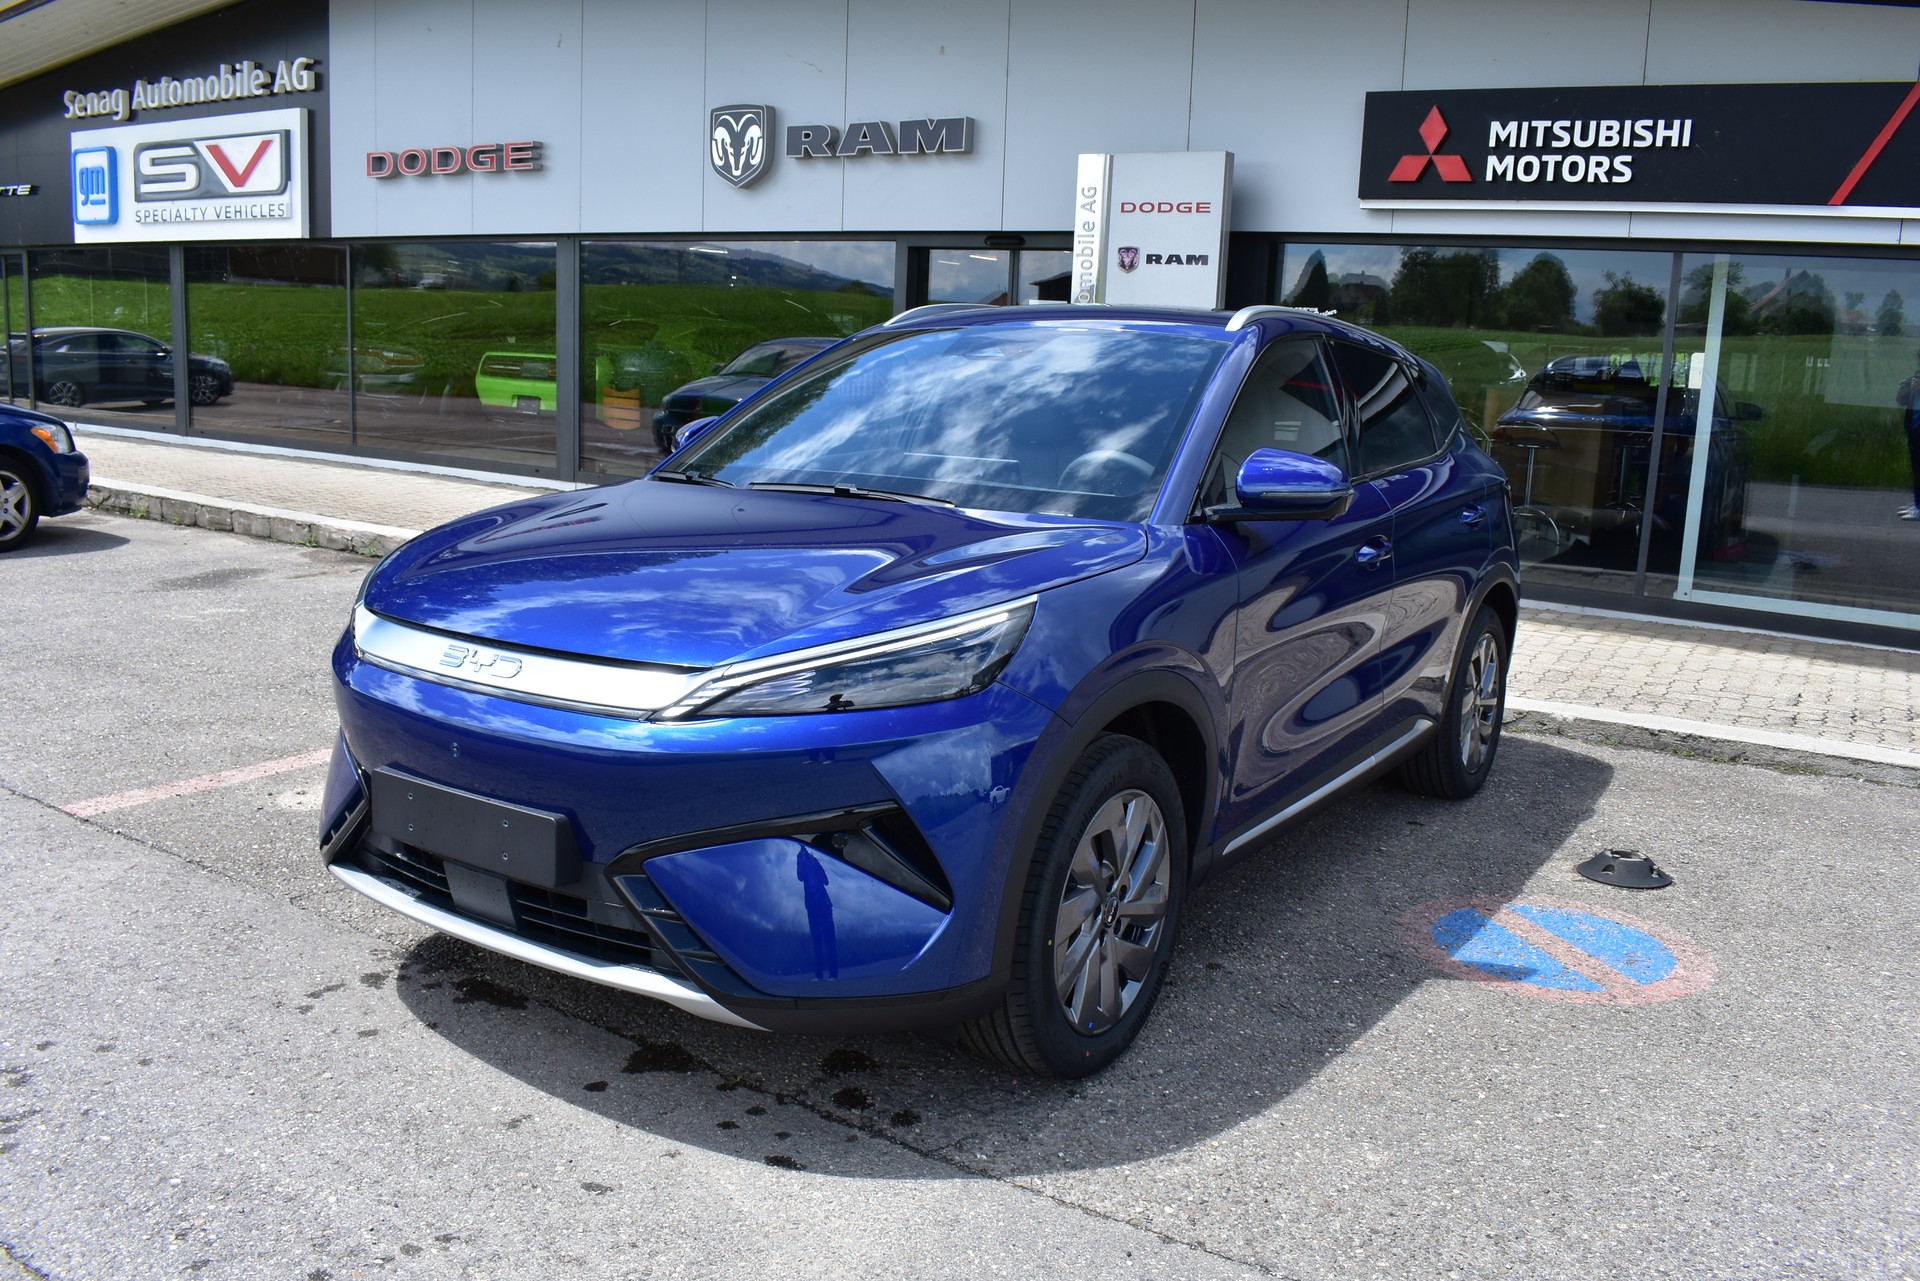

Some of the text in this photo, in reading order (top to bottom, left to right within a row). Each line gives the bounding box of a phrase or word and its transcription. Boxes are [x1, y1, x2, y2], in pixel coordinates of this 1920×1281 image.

[64, 57, 315, 121] Senag Automobile AG
[785, 116, 975, 159] RAM
[1488, 118, 1693, 149] MITSUBISHI
[366, 141, 543, 178] DODGE
[1485, 154, 1634, 184] MOTORS
[135, 203, 286, 223] SPECIALTY VEHICLES
[1080, 186, 1097, 213] AG
[1120, 202, 1212, 214] DODGE
[1145, 254, 1209, 266] RAM
[439, 645, 523, 679] BYD
